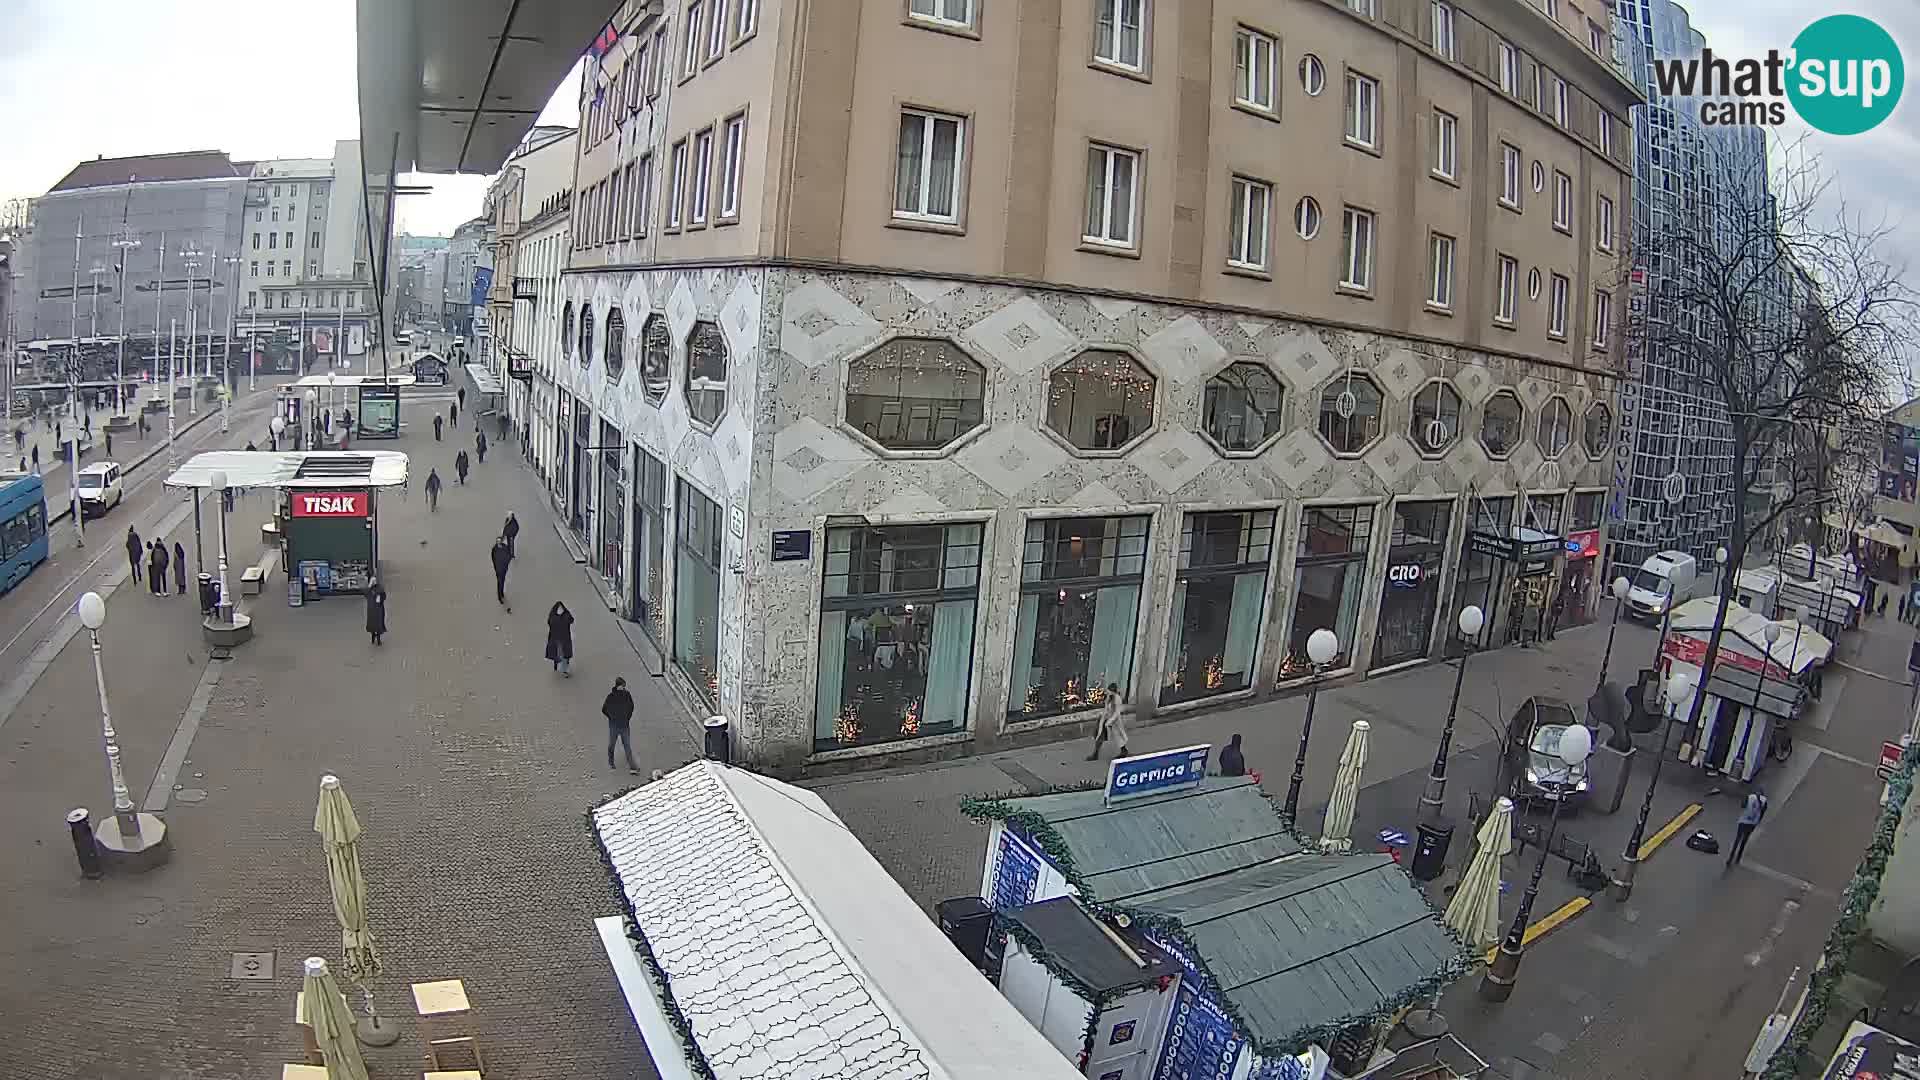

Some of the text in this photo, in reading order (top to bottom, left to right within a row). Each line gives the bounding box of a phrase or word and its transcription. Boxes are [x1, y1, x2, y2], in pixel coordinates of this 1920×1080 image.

[1608, 383, 1637, 520] DUBROVNIK
[303, 496, 356, 513] TISAK
[1389, 564, 1420, 581] CRO
